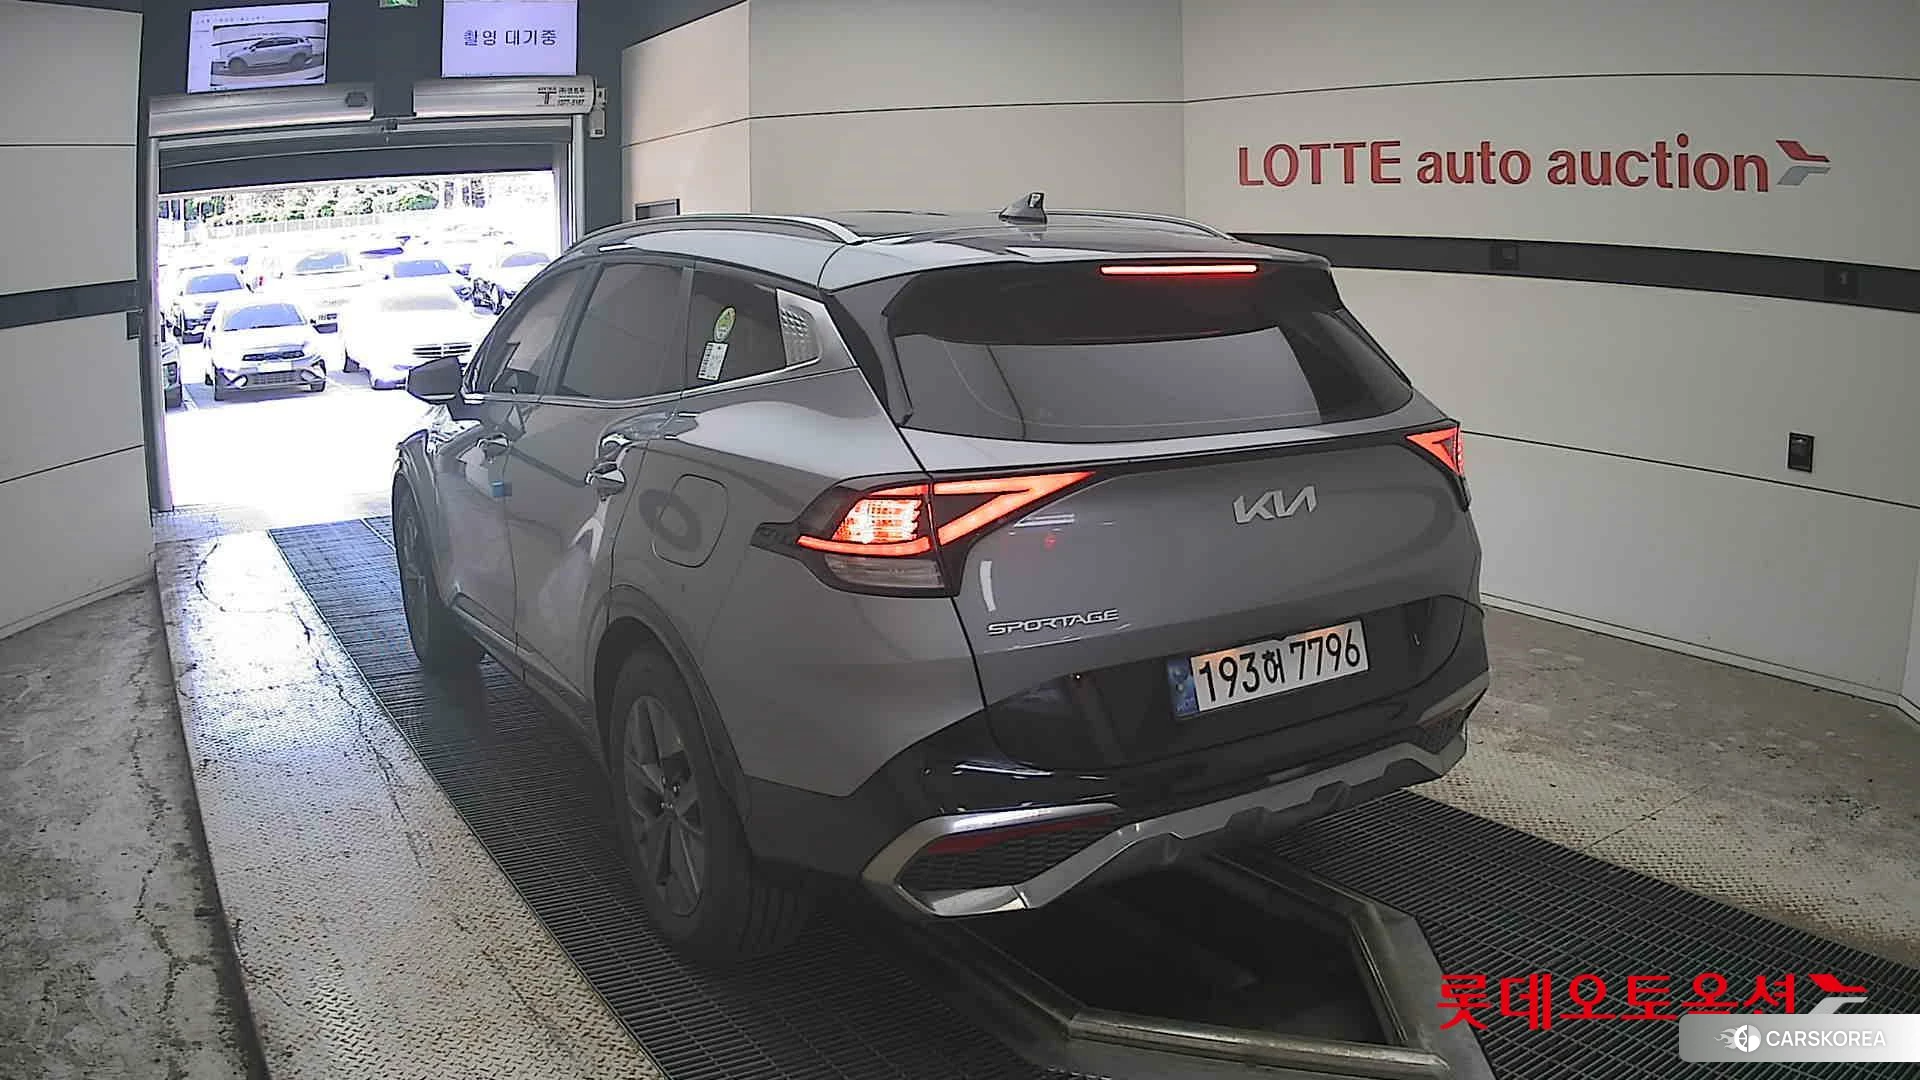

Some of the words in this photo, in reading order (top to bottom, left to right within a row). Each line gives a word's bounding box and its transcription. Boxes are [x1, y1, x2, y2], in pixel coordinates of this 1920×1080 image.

[505, 29, 557, 46] 대기중
[1238, 140, 1401, 187] LOTTE
[1416, 141, 1532, 185] auto
[1547, 132, 1768, 192] auction
[1233, 485, 1317, 524] KIA
[987, 608, 1120, 636] SPORTAGE
[1199, 648, 1285, 703] 193허
[1289, 628, 1361, 681] 7796
